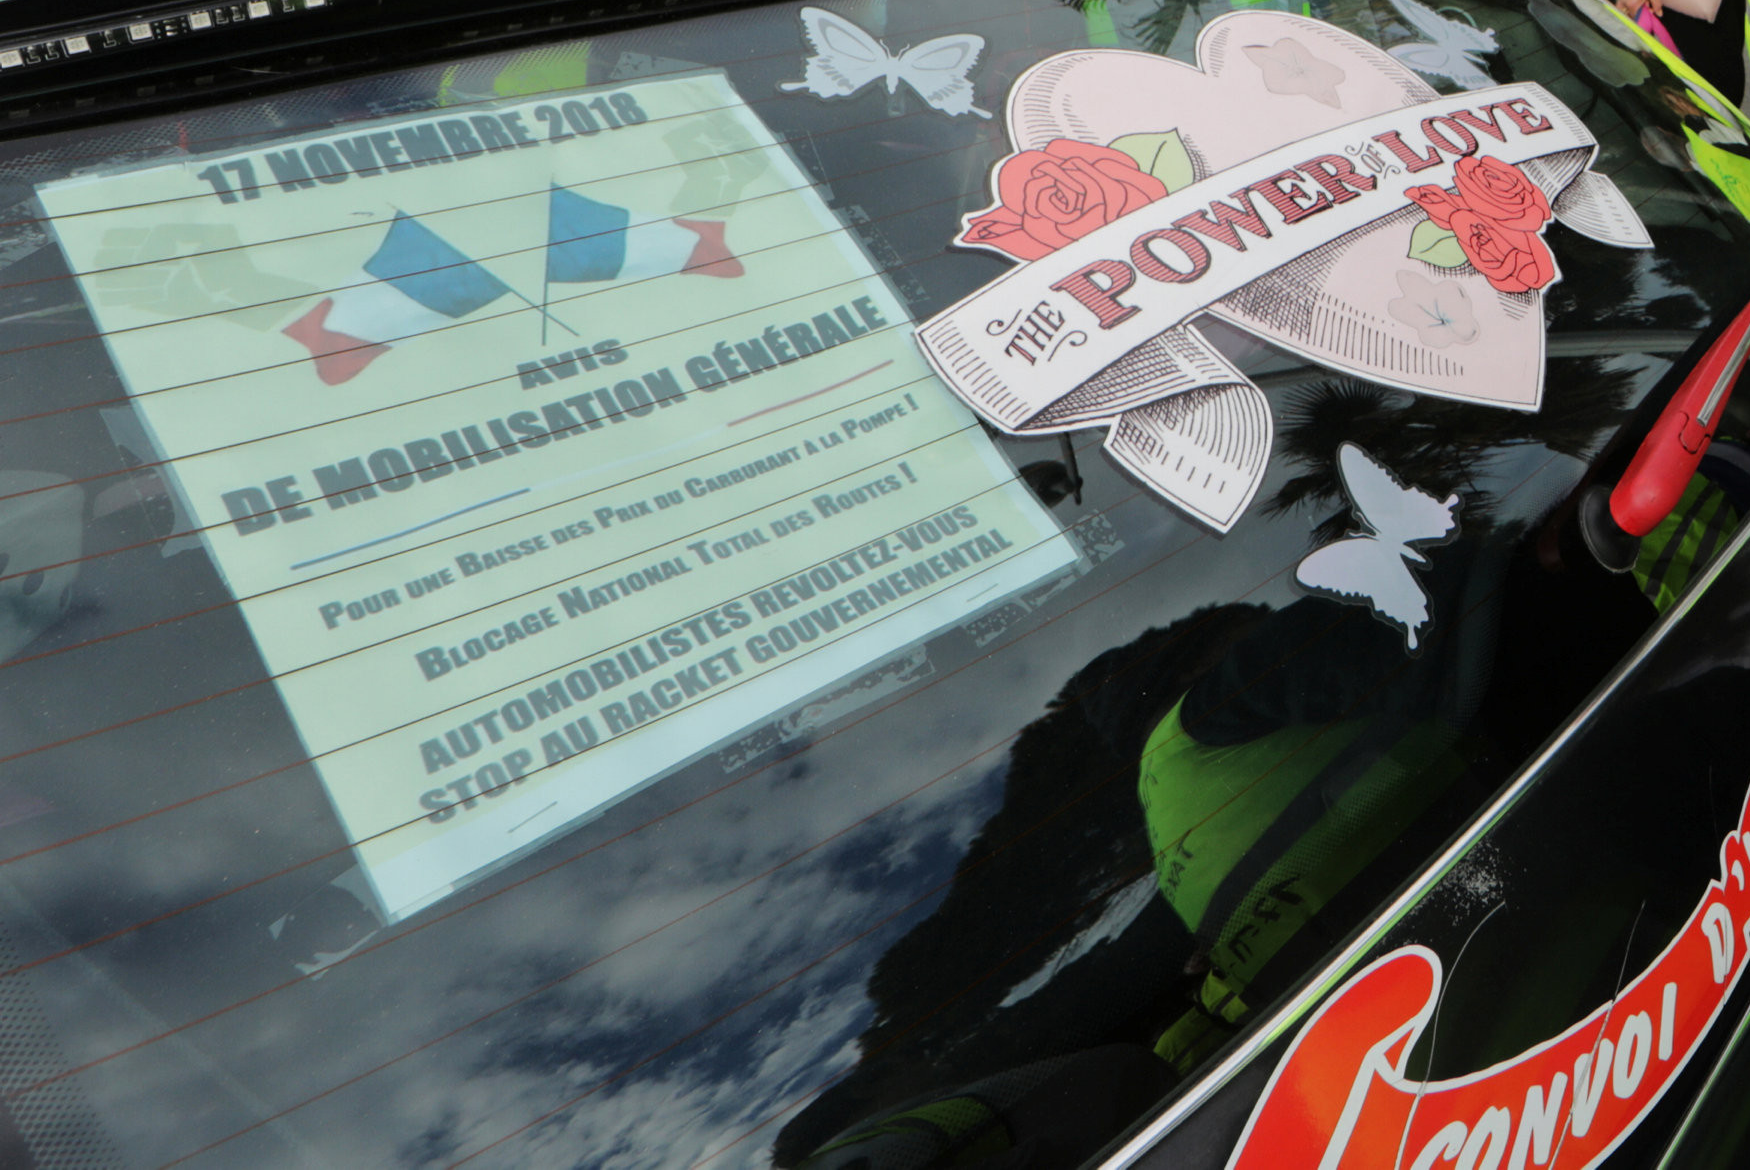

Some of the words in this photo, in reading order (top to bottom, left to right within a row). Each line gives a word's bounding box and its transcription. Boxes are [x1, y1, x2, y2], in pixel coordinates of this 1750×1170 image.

[197, 157, 262, 204] 17
[264, 109, 540, 193] NOVEMBRE
[533, 91, 649, 144] 2018
[1003, 300, 1067, 367] THE
[1050, 153, 1378, 331] POWER
[1371, 97, 1554, 175] LOVE
[221, 475, 314, 536] DE
[312, 367, 687, 510] MOBILISATION
[685, 296, 888, 393] GÉNÉRALE
[516, 338, 629, 390] AVIS
[419, 600, 752, 775] AUTOMOBILISTES
[749, 504, 979, 618] REVOLTEZ-VOUS
[419, 747, 533, 824] STOP
[540, 716, 600, 768] AU
[599, 646, 744, 736] RACKET
[745, 528, 1013, 664] GOUVERNEMENTAL
